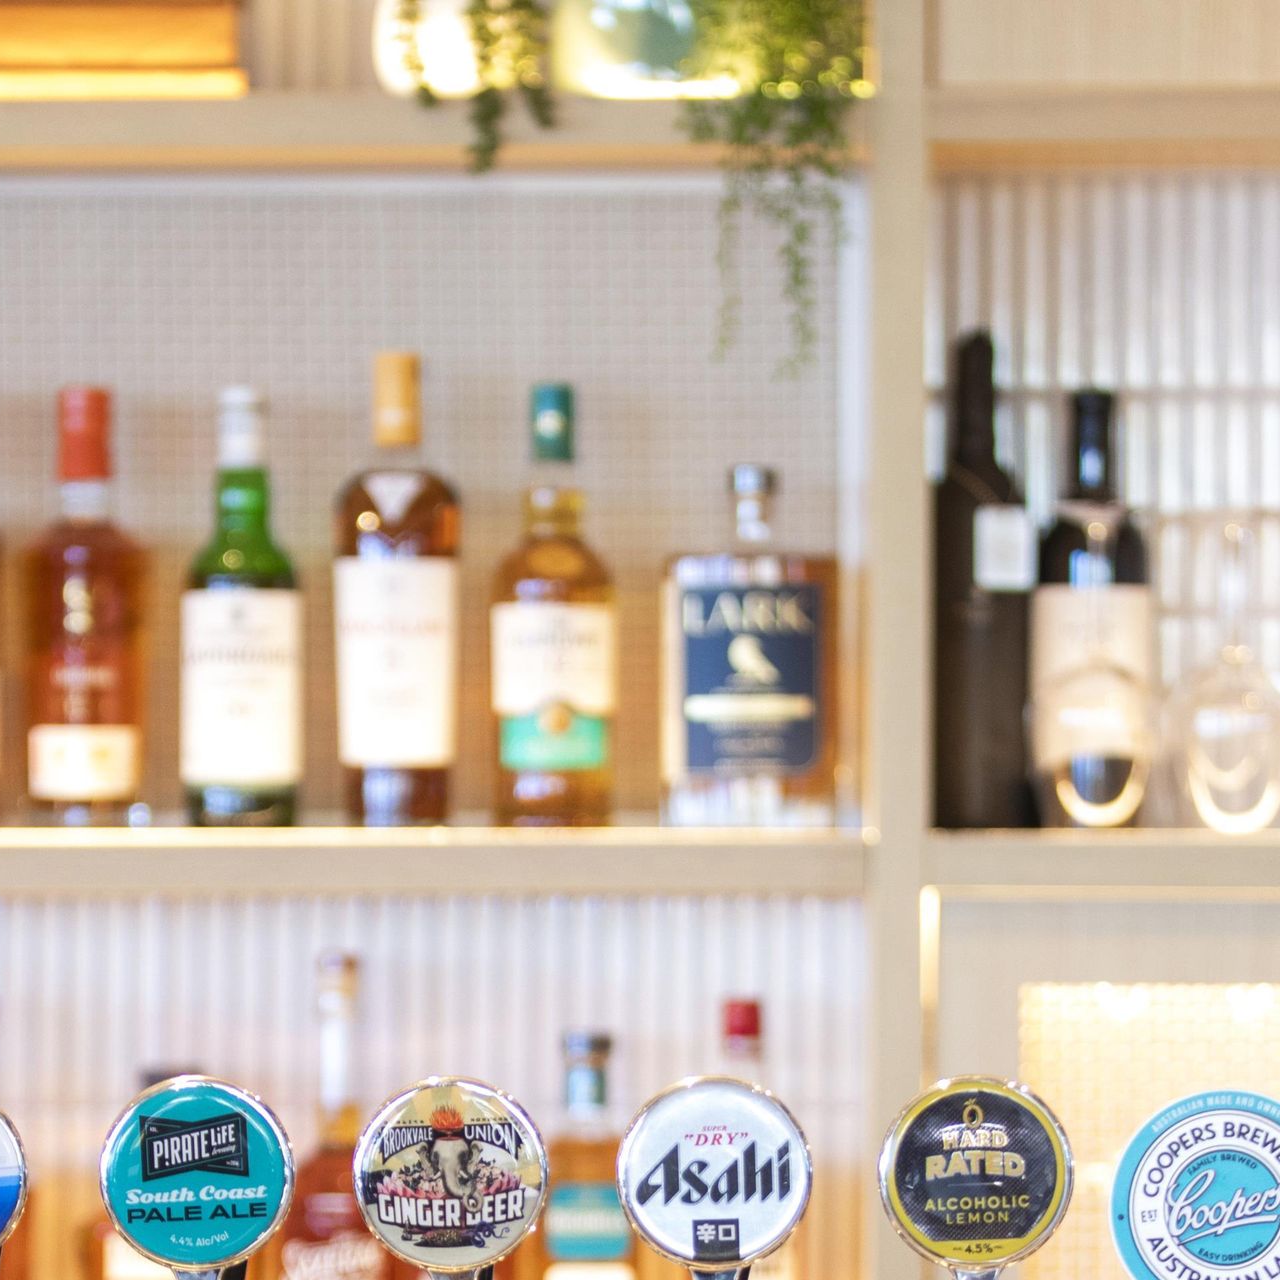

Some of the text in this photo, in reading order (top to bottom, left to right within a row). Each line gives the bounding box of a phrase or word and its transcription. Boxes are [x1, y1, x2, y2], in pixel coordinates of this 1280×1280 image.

[1207, 1096, 1232, 1106] MADE
[1235, 1096, 1254, 1107] AND
[383, 1124, 516, 1160] BROOKVALE UNION
[942, 1130, 1008, 1150] HARD
[925, 1151, 1025, 1181] RATED
[1143, 1123, 1216, 1198] COOPERS
[1187, 1154, 1257, 1175] FAMILY BREWED
[635, 1140, 791, 1206] Asahi
[125, 1185, 268, 1205] South Coast
[925, 1195, 1030, 1211] ALCOHOLIC
[128, 1202, 267, 1224] PALE ALE
[379, 1194, 460, 1227] GINGER
[947, 1211, 1009, 1225] LEMON
[1141, 1209, 1157, 1222] EST
[170, 1231, 229, 1246] 4.4% Alc/Vol
[697, 1224, 736, 1243] 辛口
[965, 1243, 993, 1253] 4.5%
[1198, 1242, 1263, 1261] EASY DRINKING
